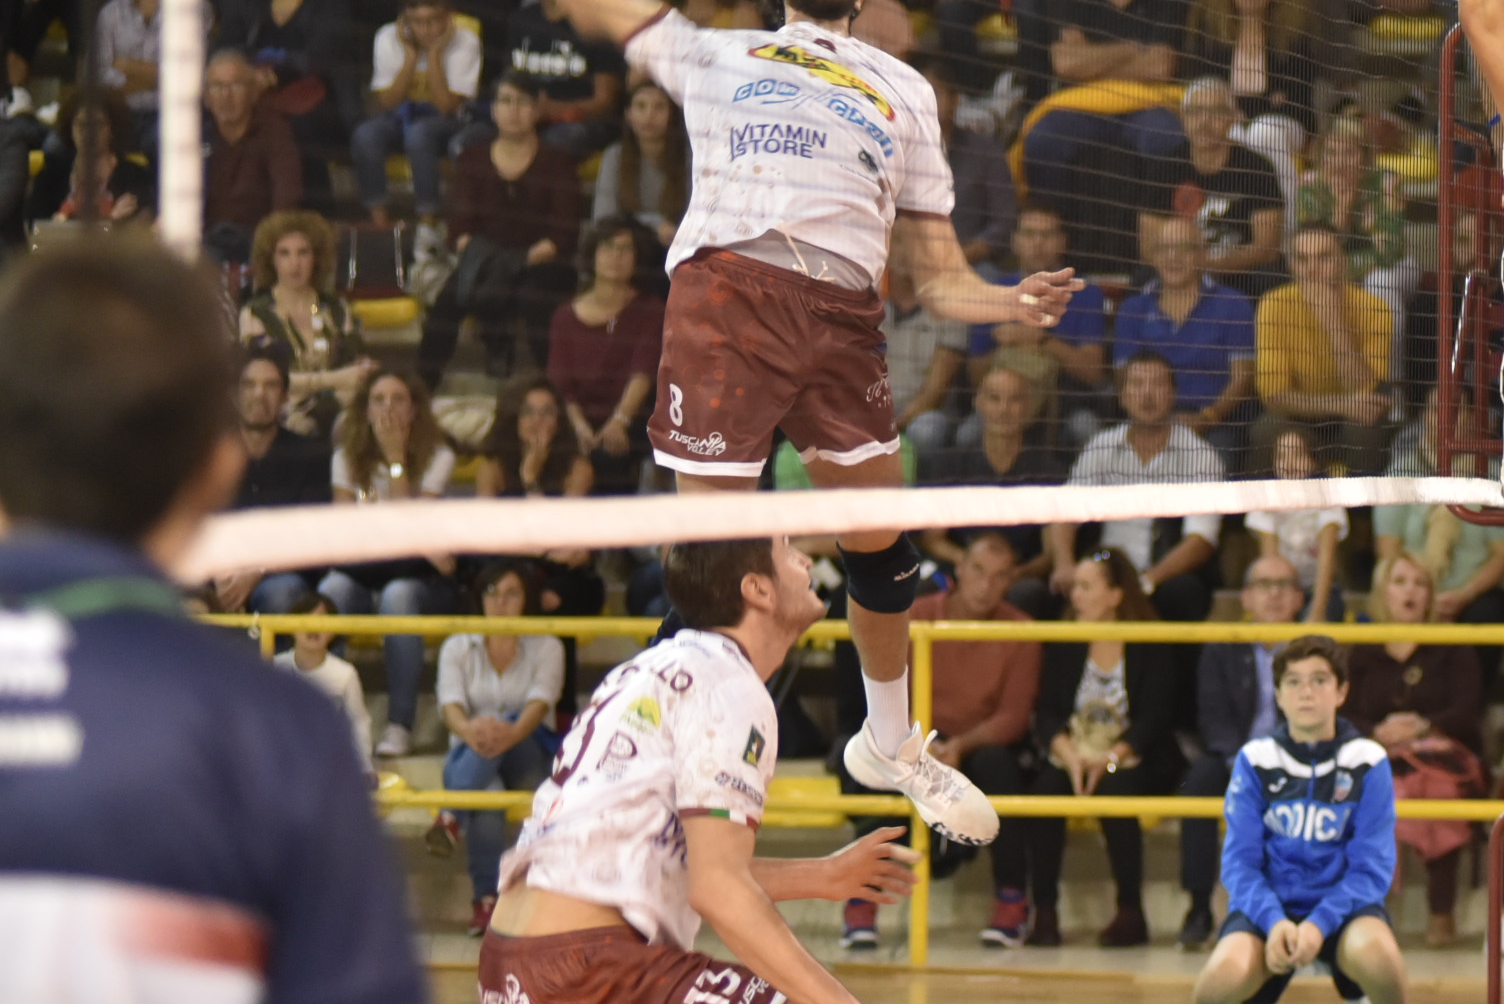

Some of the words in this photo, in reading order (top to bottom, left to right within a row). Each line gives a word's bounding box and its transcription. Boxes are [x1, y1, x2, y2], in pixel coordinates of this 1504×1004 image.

[735, 123, 828, 149] VITAMIN
[735, 138, 814, 159] STORE
[669, 383, 683, 427] 8
